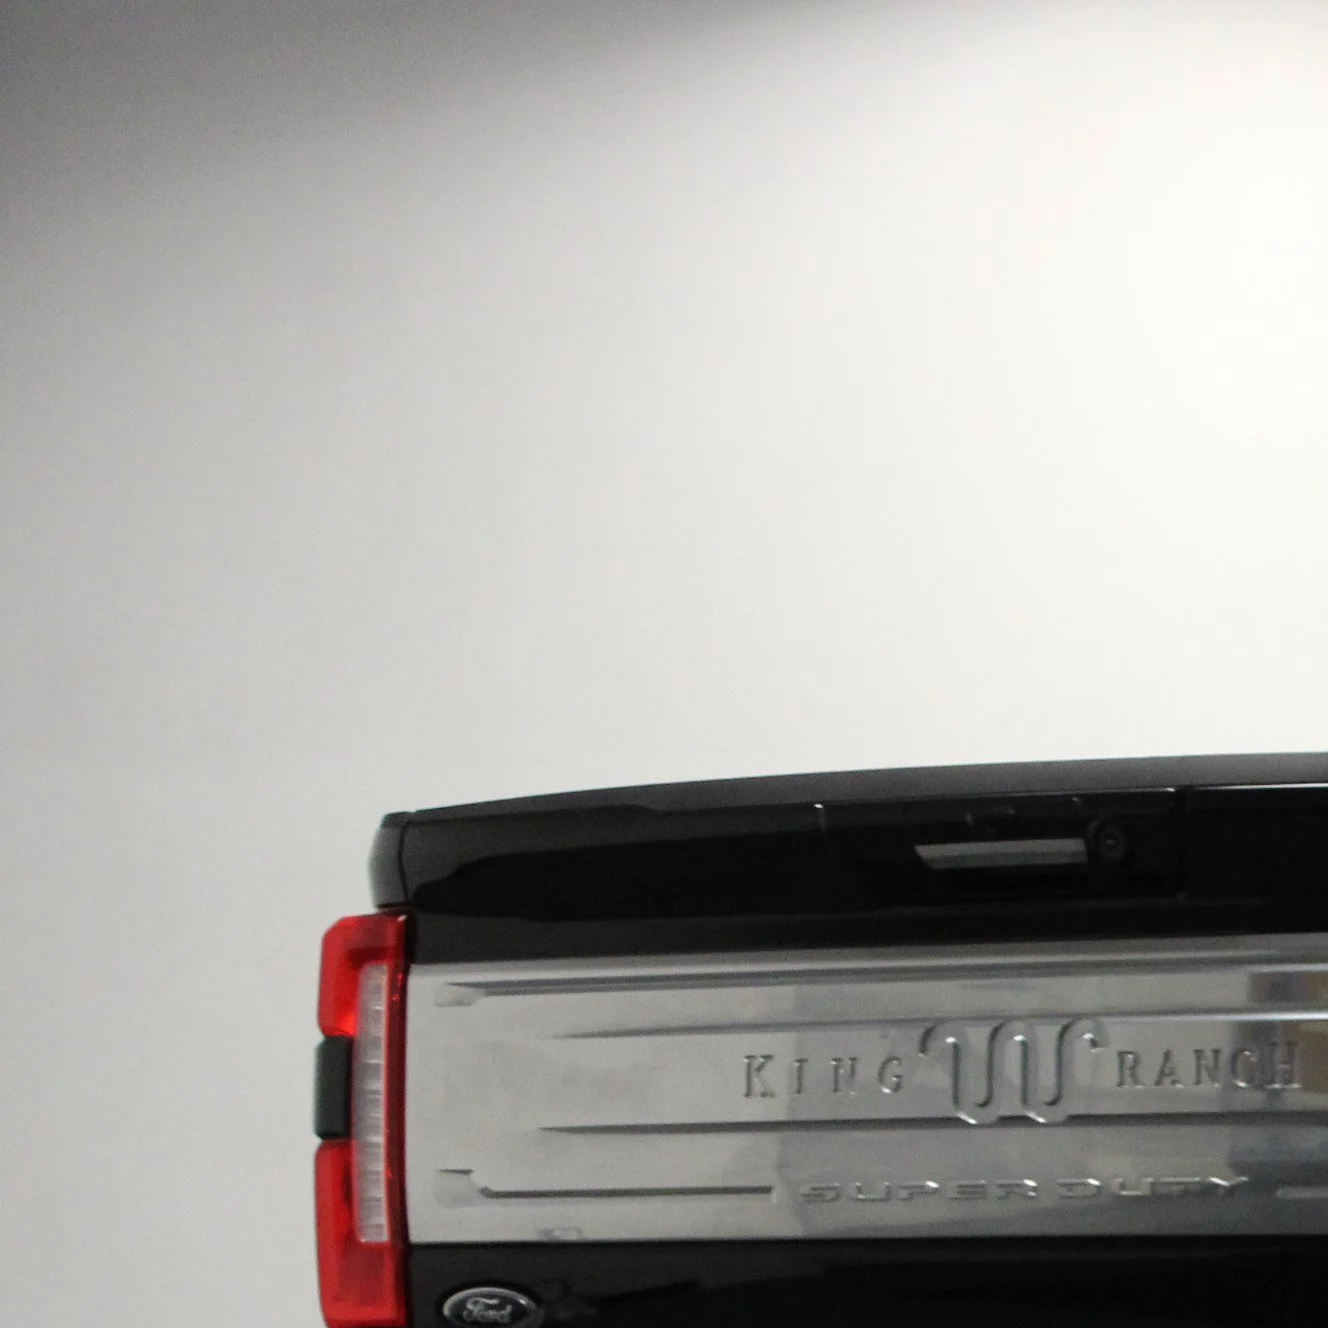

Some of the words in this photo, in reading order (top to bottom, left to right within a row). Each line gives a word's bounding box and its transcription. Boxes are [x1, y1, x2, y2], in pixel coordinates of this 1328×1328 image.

[743, 1053, 905, 1099] KING
[1116, 1042, 1303, 1090] RANCH
[799, 1178, 1040, 1204] SUPER
[1054, 1176, 1248, 1199] DUTY
[462, 1297, 513, 1324] Ford
